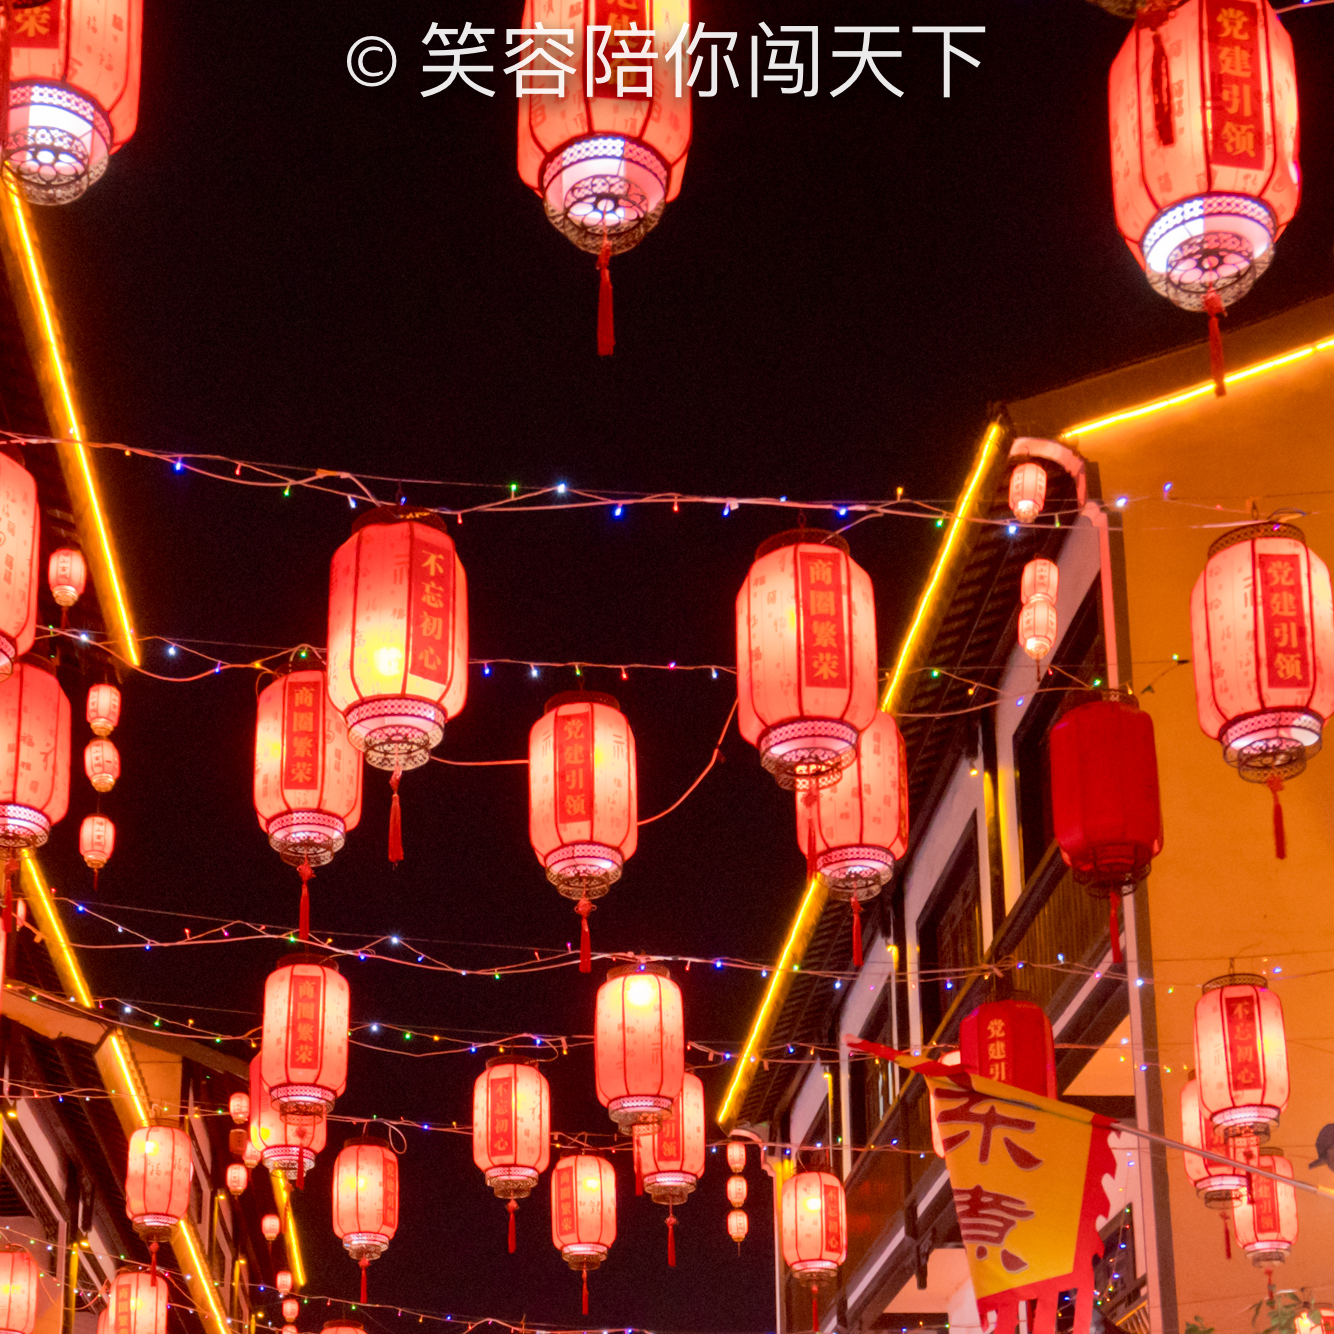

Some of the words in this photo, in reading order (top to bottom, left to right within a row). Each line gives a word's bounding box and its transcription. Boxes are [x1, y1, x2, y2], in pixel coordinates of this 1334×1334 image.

[1216, 5, 1259, 159] 党建引领
[418, 551, 446, 672] 不忘初心
[808, 558, 841, 680] 商圈繁荣
[1268, 560, 1303, 681] 党建引领
[291, 686, 315, 784] 商圈繁荣
[563, 718, 586, 817] 党建引领
[297, 981, 315, 1063] 商圈繁荣
[1232, 1002, 1255, 1084] 不忘初心
[494, 1081, 510, 1151] 不忘初心
